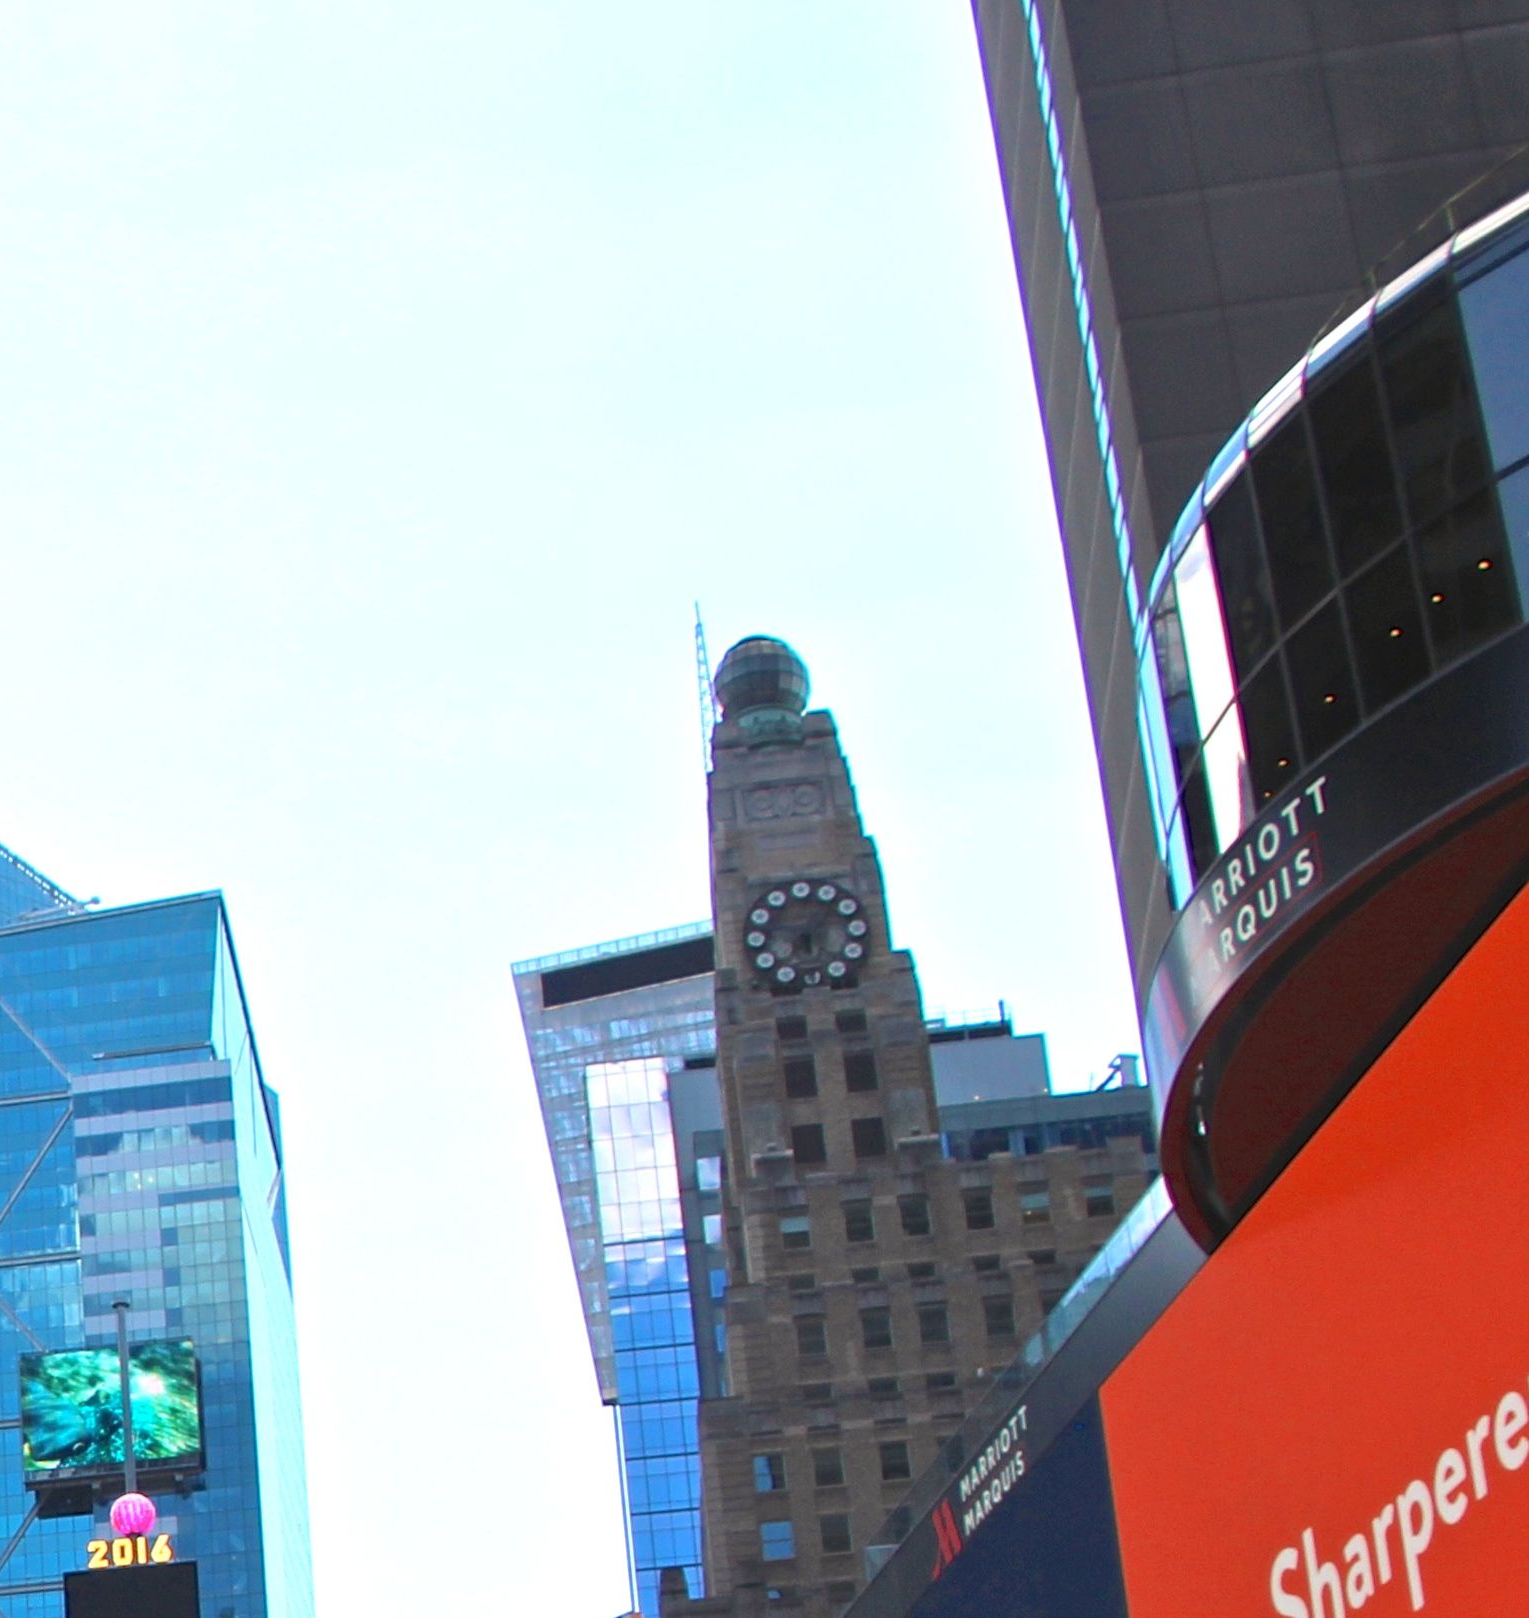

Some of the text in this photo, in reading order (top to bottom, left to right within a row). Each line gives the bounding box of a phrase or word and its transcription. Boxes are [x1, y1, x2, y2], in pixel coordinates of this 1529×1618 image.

[1199, 776, 1327, 927] ARRIOTT
[1208, 848, 1314, 972] ARQUIS
[957, 1404, 1030, 1507] MARRIOTT
[962, 1450, 1027, 1538] MARQUIS
[87, 1531, 176, 1570] 2016
